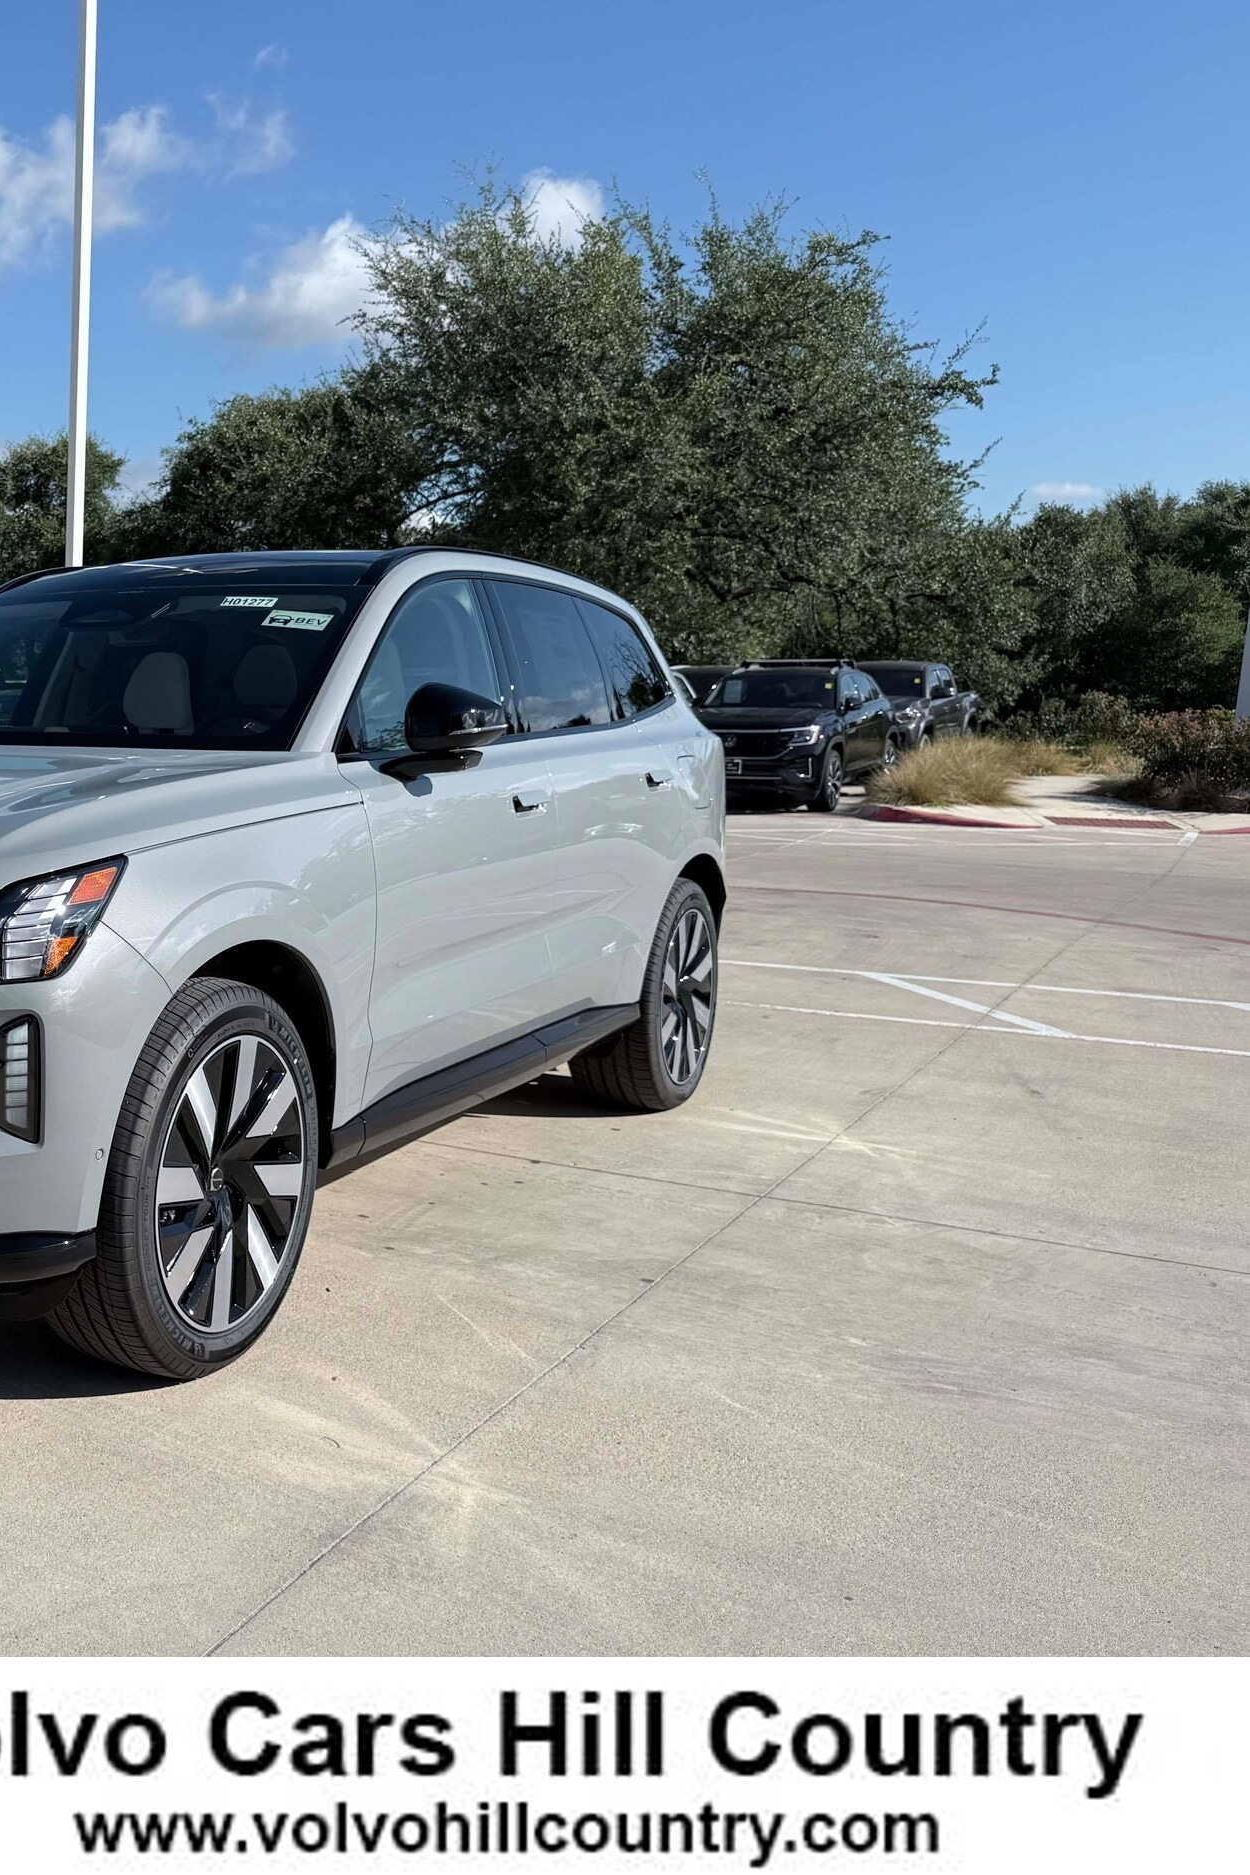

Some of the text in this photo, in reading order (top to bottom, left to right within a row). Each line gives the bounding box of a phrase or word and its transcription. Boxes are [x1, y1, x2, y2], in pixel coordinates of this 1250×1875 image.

[222, 598, 274, 606] H01277
[295, 617, 327, 626] BEV
[279, 1027, 313, 1095] MICHELIN
